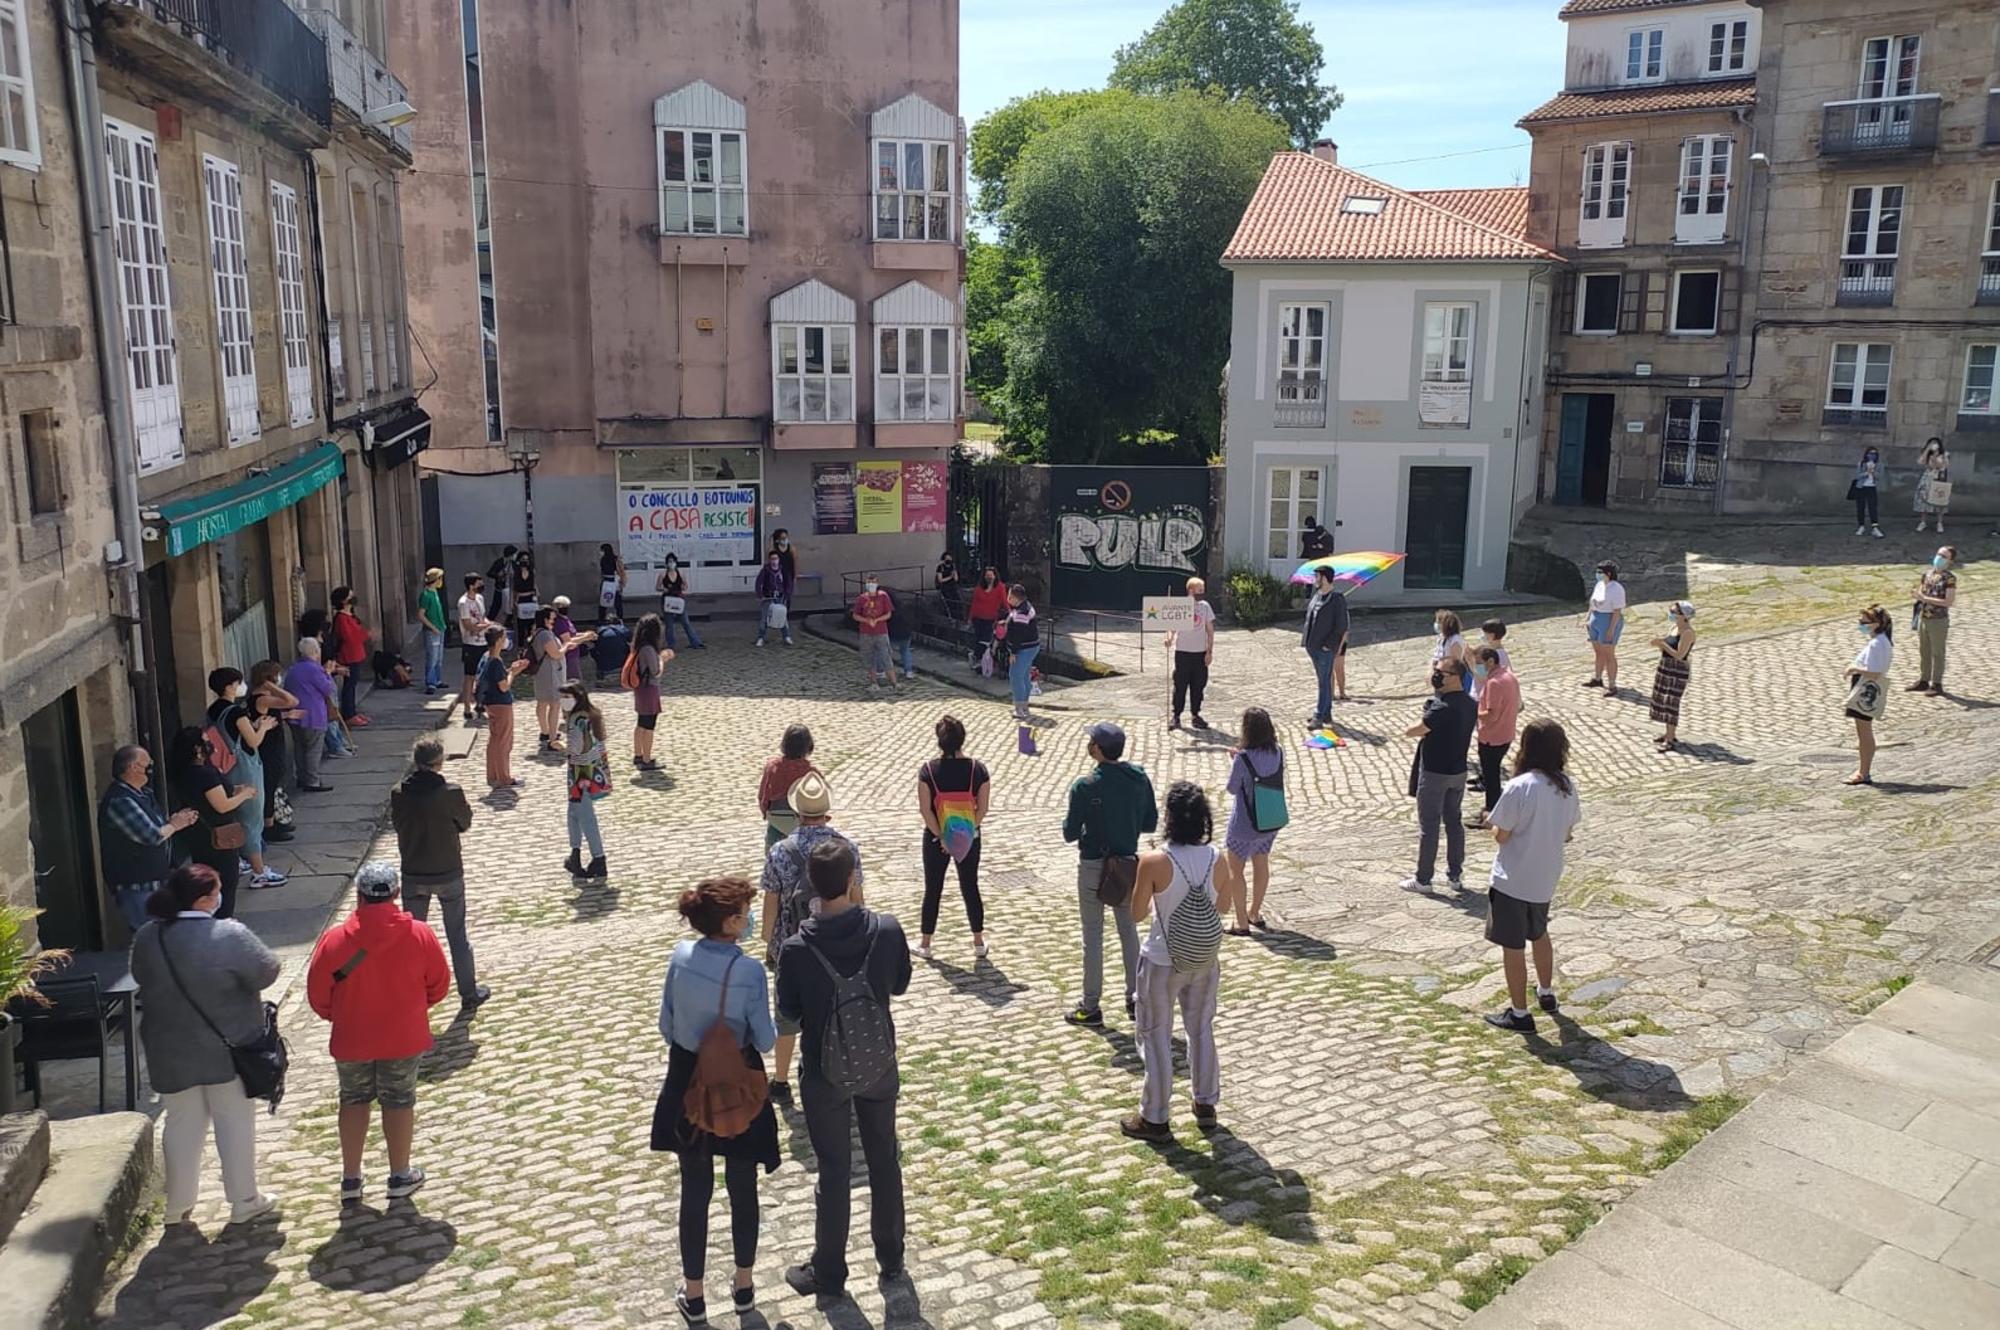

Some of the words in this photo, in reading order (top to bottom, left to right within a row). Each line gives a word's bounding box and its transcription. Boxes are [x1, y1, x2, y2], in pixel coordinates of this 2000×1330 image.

[628, 494, 637, 508] O
[641, 492, 699, 508] CONCELLO
[629, 516, 644, 532] A
[650, 508, 701, 530] CASA
[1161, 611, 1192, 620] LGBT+
